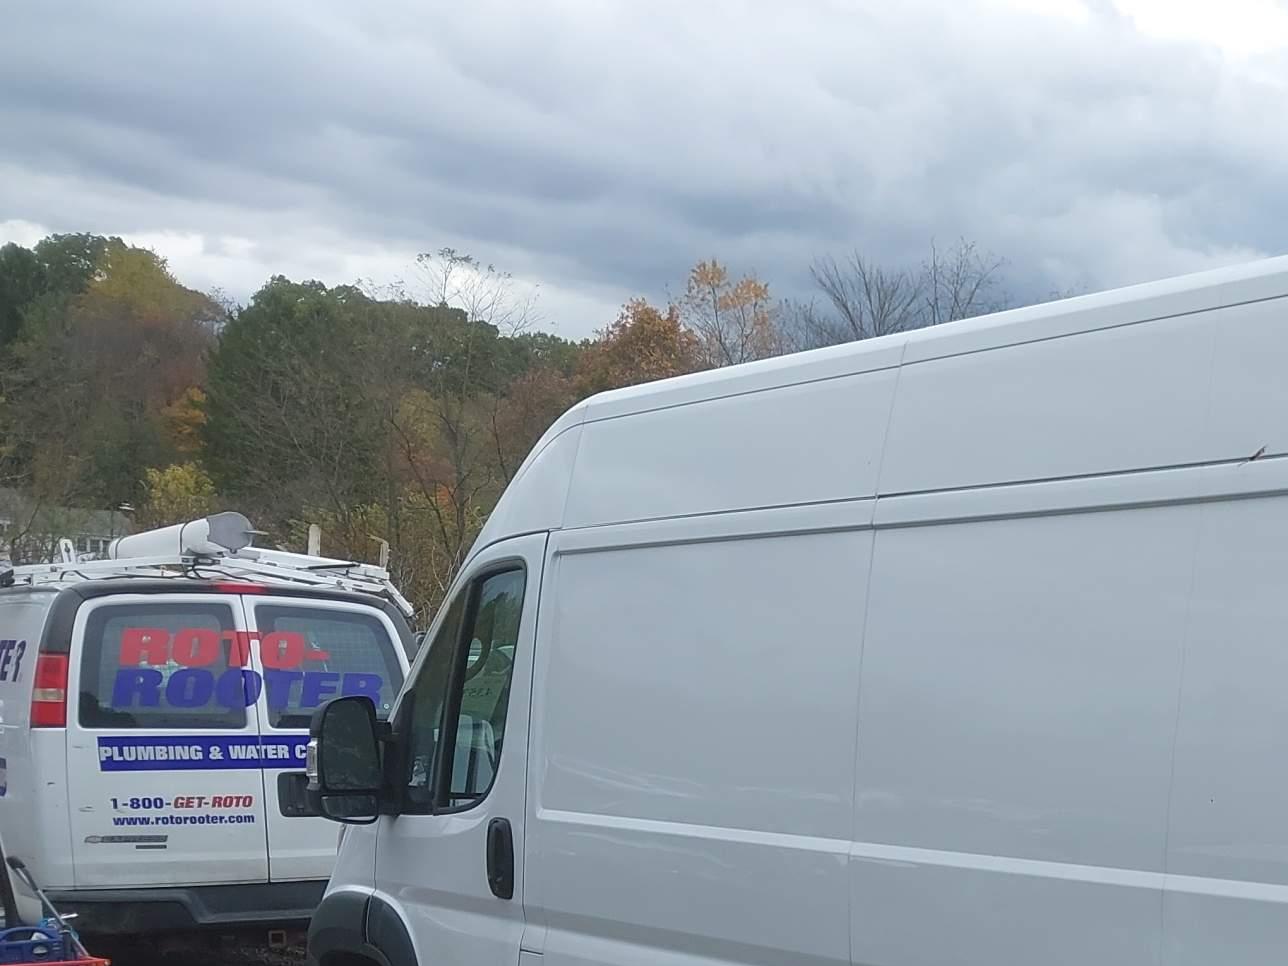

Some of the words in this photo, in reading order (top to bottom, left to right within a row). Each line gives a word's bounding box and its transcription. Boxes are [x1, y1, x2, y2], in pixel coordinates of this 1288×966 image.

[118, 627, 331, 669] ROTO-
[111, 668, 384, 709] ROOTER
[100, 745, 203, 761] PLUMBING
[209, 745, 223, 759] &
[229, 744, 289, 760] WATER
[110, 795, 253, 809] 1-800-GET-ROTO
[113, 813, 255, 826] www.rotorooter.com
